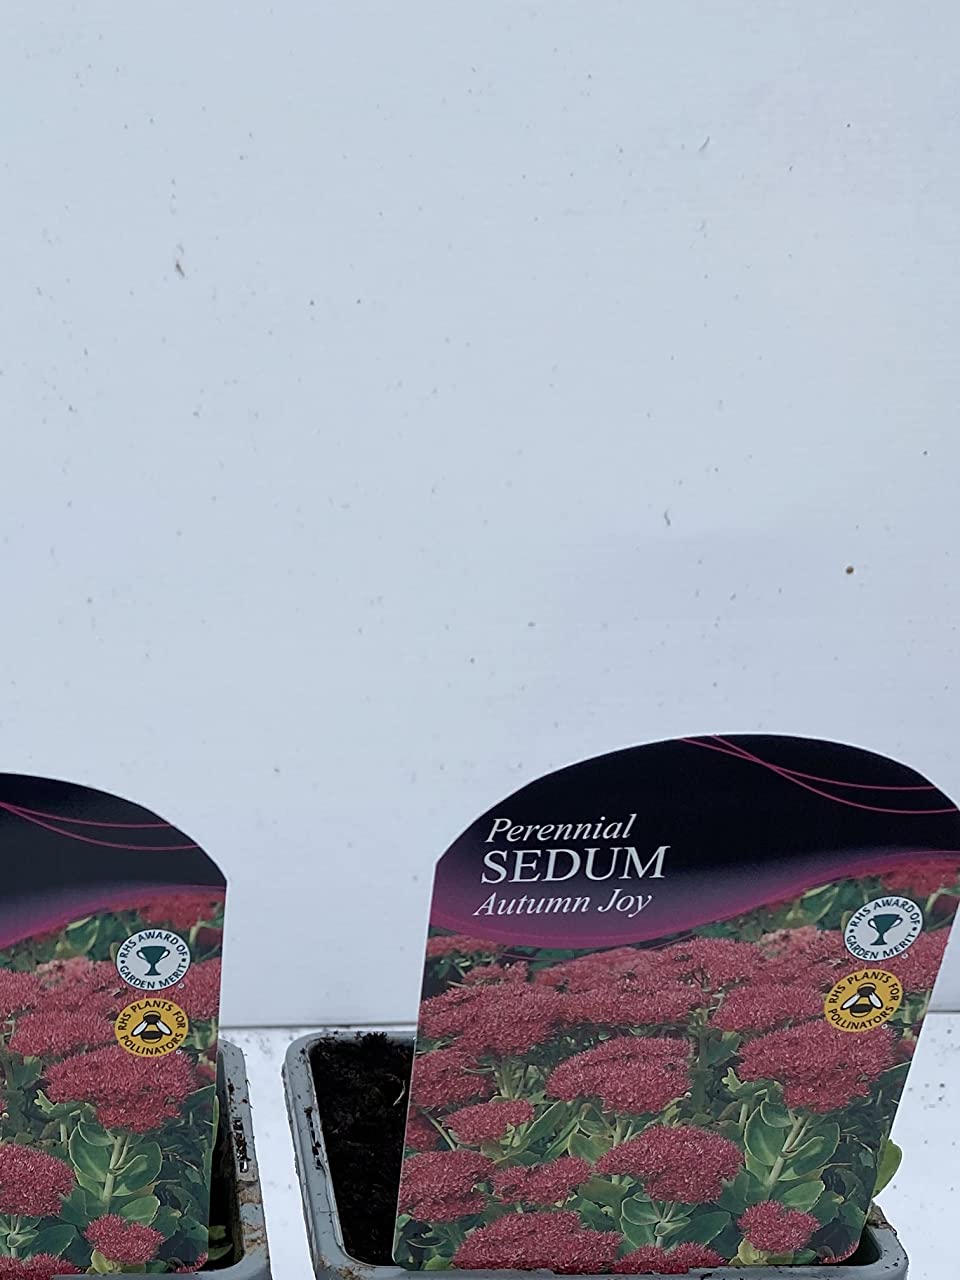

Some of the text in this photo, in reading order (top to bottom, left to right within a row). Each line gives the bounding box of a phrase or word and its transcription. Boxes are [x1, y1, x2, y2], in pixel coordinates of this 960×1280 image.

[484, 813, 637, 843] Perennial
[480, 845, 671, 884] SEDUM
[472, 888, 653, 918] Autumn Joy
[850, 898, 920, 927] RHS AWARD OF
[120, 931, 188, 958] RHS AWARD OF
[846, 932, 916, 959] GARDEN MERIT
[120, 963, 187, 989] GARDEN MERIT
[829, 971, 900, 1004] RHS PLANTS FOR
[118, 1000, 186, 1030] RHS PLANTS FOR
[828, 1005, 894, 1030] POLLINATORS
[120, 1033, 184, 1055] POLLINATORS
